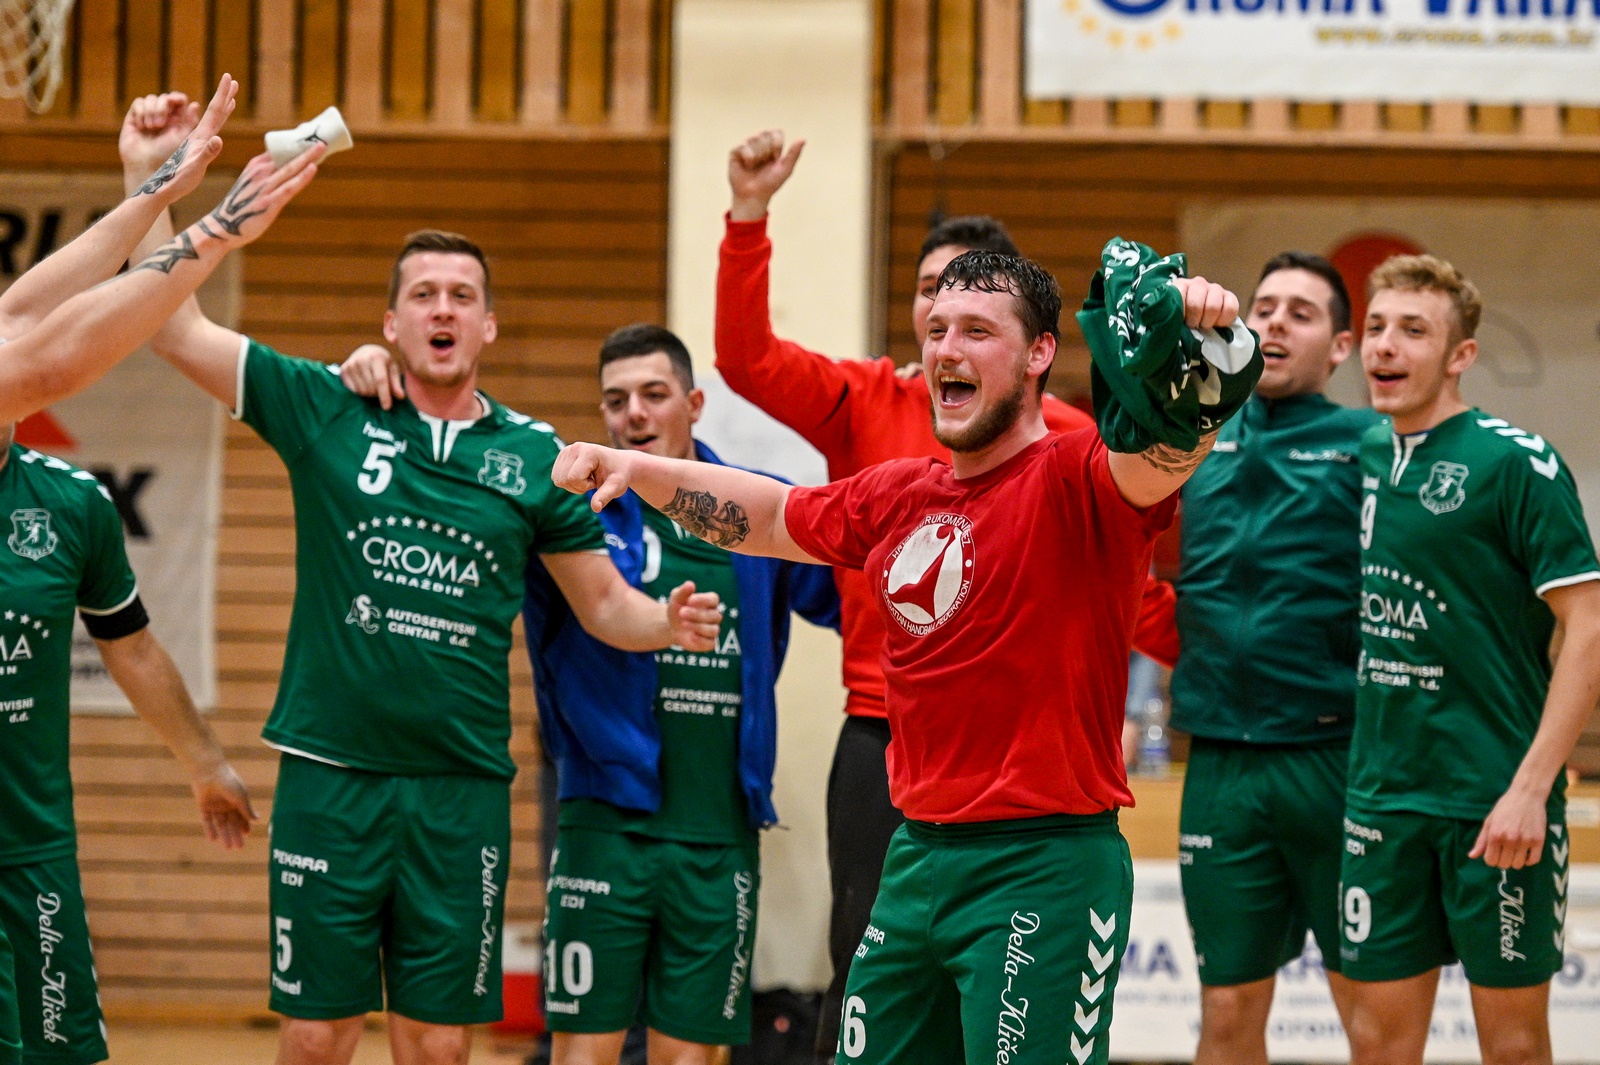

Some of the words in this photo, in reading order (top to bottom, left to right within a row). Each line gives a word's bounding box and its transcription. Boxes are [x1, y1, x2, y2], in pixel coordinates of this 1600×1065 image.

[357, 441, 398, 496] 5
[362, 536, 480, 588] CROMA
[385, 607, 478, 637] AUTOSERVISNI
[387, 620, 442, 643] CENTAR
[280, 870, 304, 888] EDI
[560, 893, 586, 910] EDI
[275, 916, 293, 974] 5
[546, 939, 594, 997] 10
